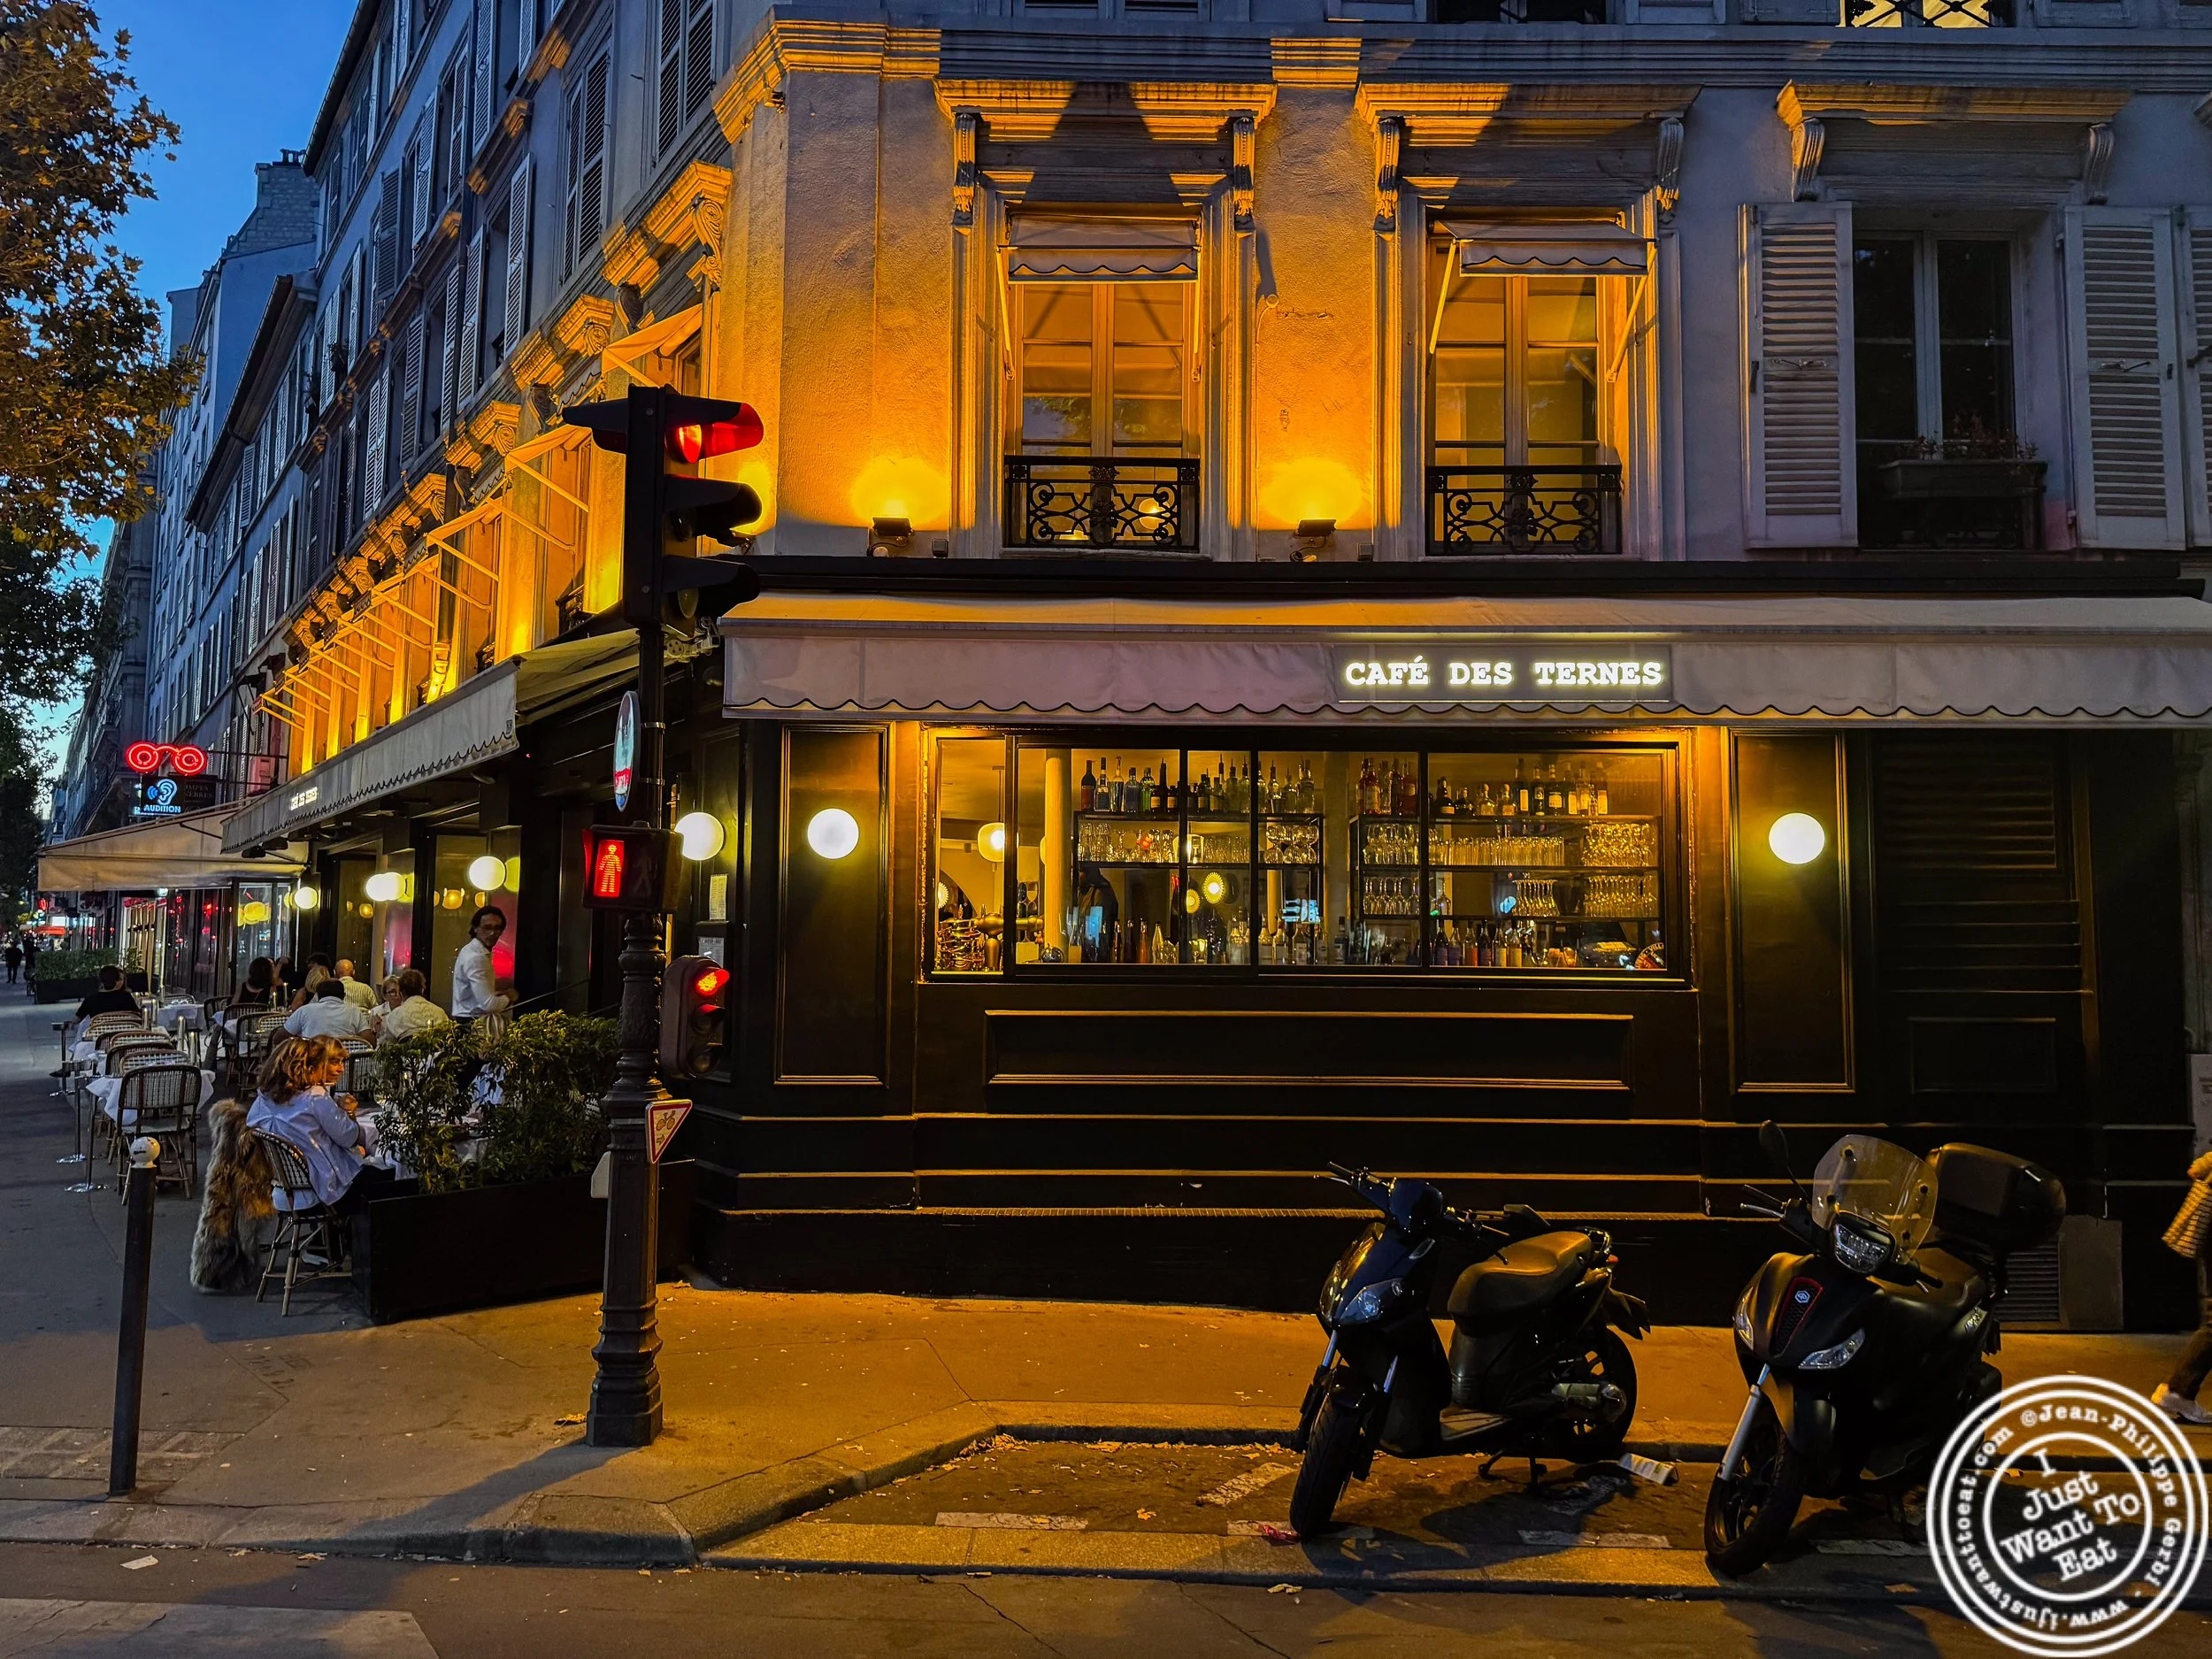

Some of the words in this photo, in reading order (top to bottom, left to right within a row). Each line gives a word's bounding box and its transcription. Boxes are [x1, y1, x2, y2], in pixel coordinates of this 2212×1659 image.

[1346, 656, 1429, 685] CAFÉ
[1450, 662, 1512, 685] DES
[1535, 662, 1662, 685] TERNES
[143, 804, 181, 813] AUDITION
